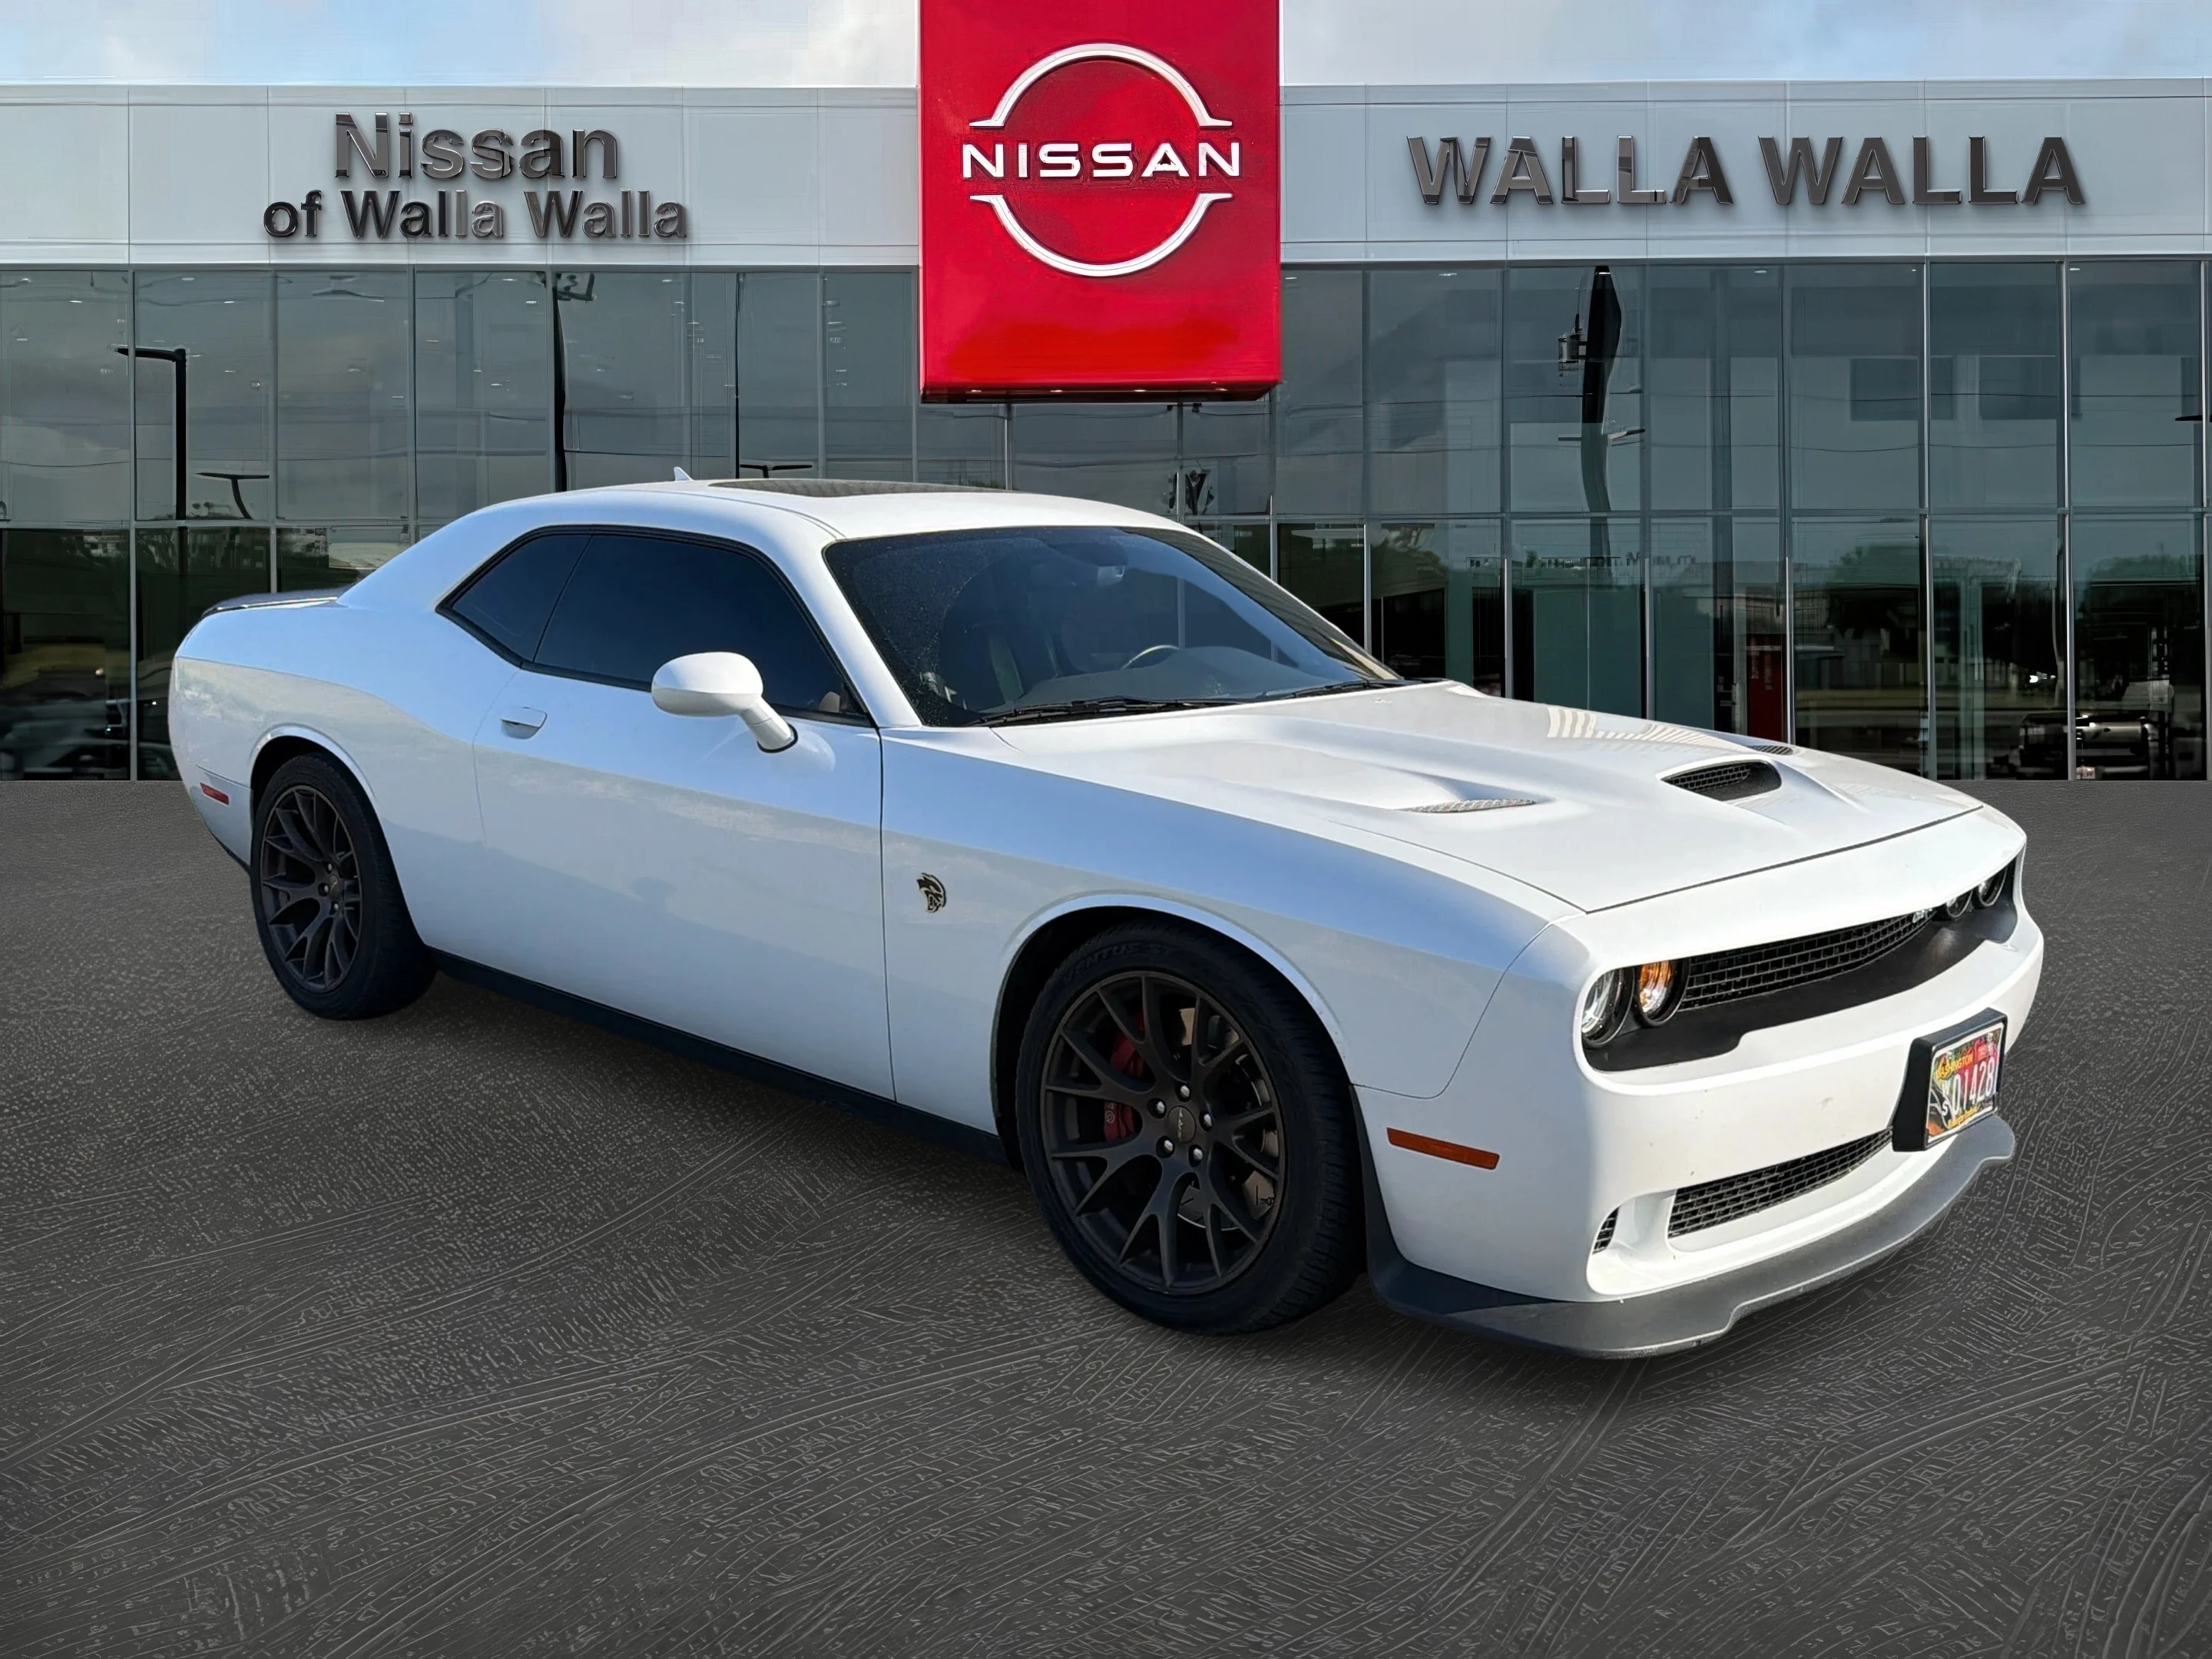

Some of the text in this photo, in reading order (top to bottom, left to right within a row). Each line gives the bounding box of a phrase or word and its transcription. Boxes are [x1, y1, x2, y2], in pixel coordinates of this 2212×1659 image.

[335, 111, 618, 179] Nissan
[962, 142, 1240, 177] NISSAN
[1406, 136, 2086, 205] WALLA WALLA
[263, 189, 687, 238] of Walla Walla
